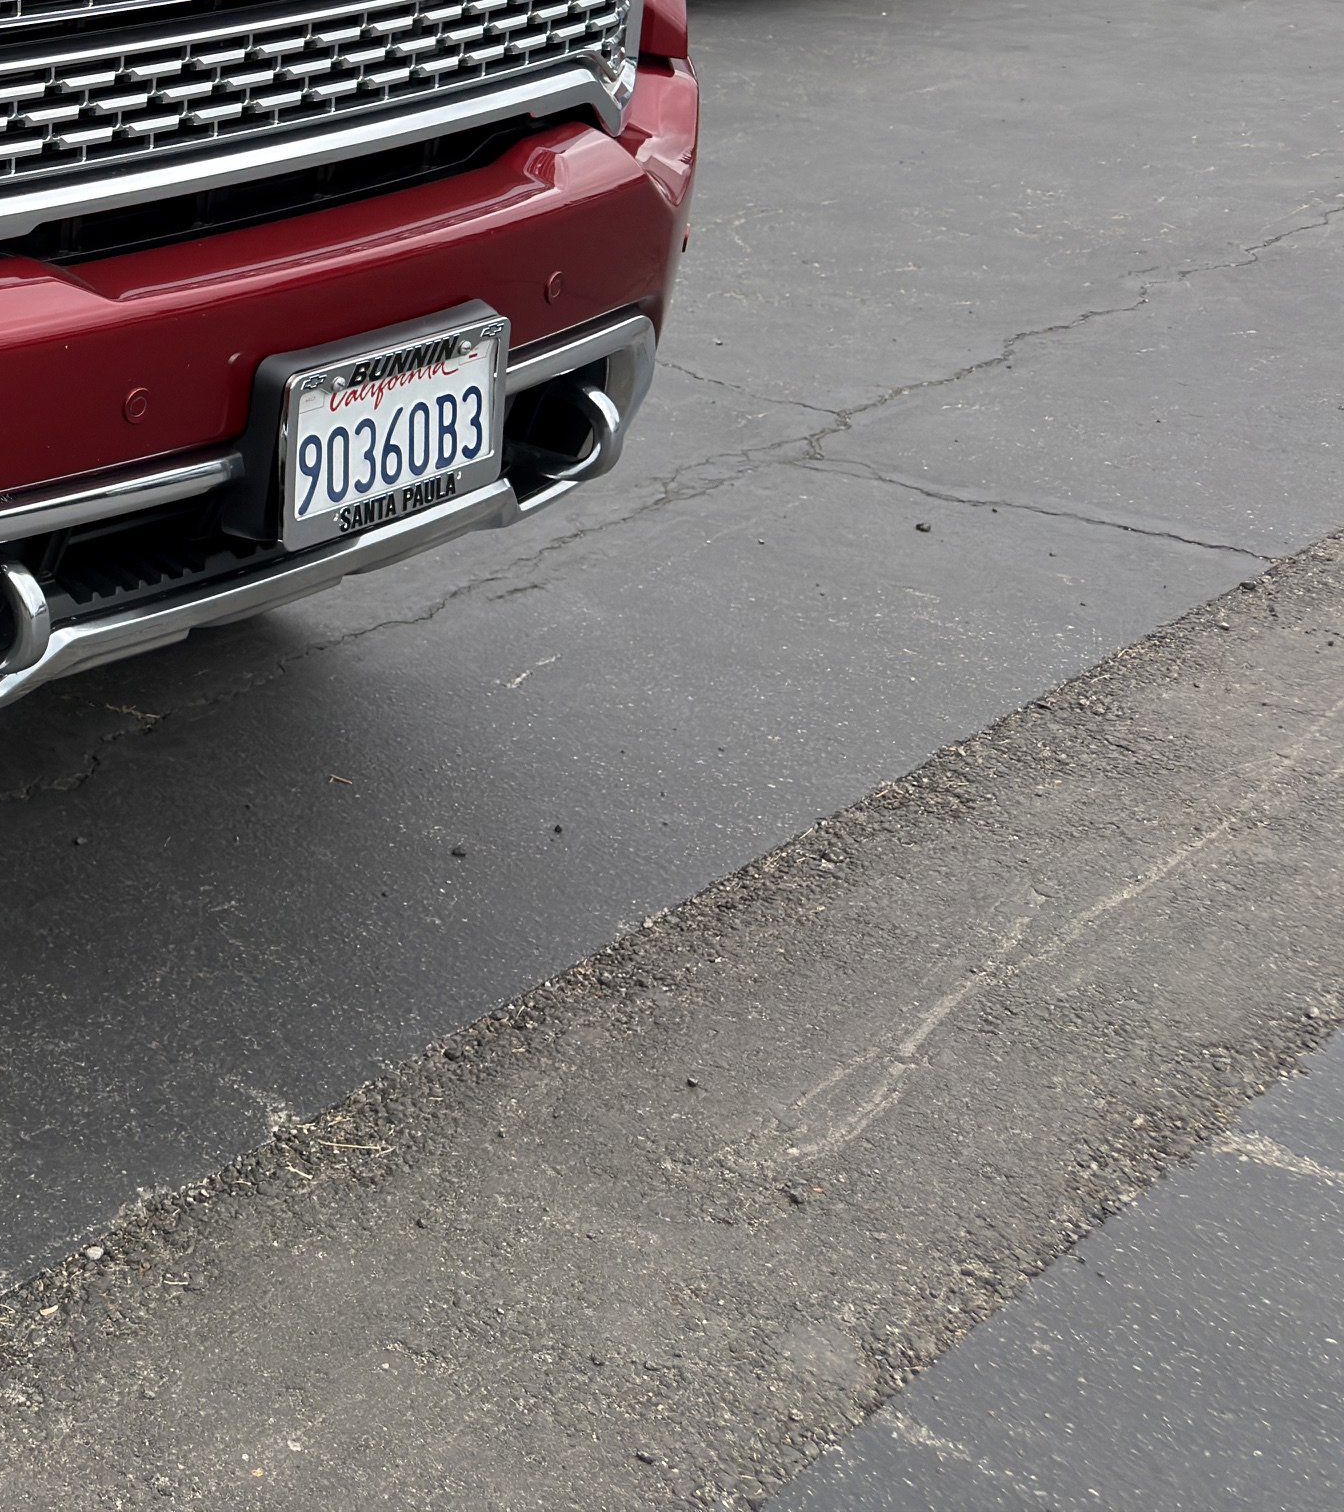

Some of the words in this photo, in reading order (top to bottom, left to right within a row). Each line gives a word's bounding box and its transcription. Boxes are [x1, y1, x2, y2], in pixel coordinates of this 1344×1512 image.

[348, 334, 460, 388] BUNNIN
[298, 385, 483, 517] 90360B3
[339, 496, 396, 533] SANTA
[401, 472, 456, 512] PAULA
